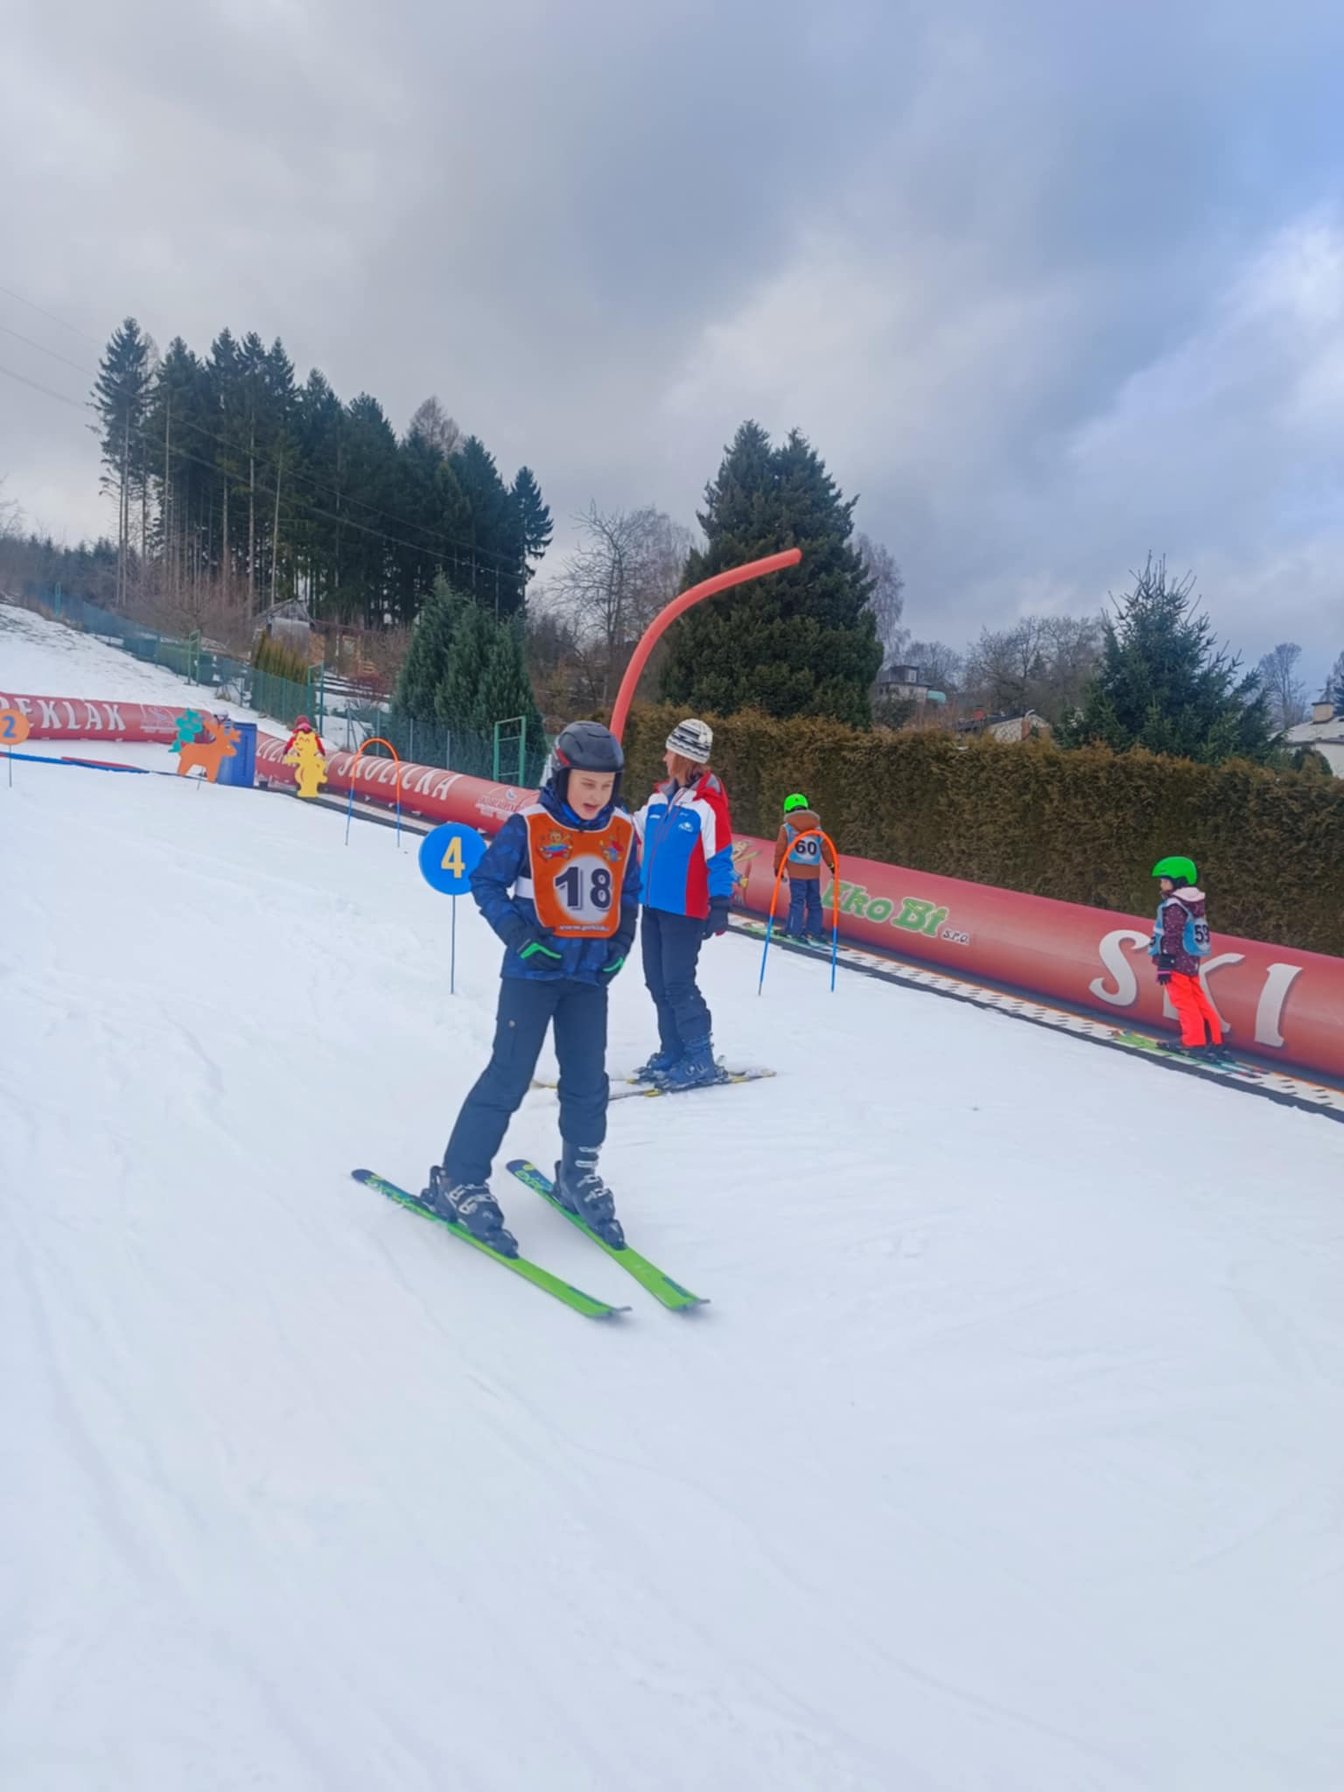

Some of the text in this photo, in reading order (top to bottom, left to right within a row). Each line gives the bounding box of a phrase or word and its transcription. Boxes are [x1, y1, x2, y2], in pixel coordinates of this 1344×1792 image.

[2, 715, 17, 738] 2
[441, 836, 466, 878] 4
[795, 839, 818, 855] 60
[555, 866, 613, 909] 18
